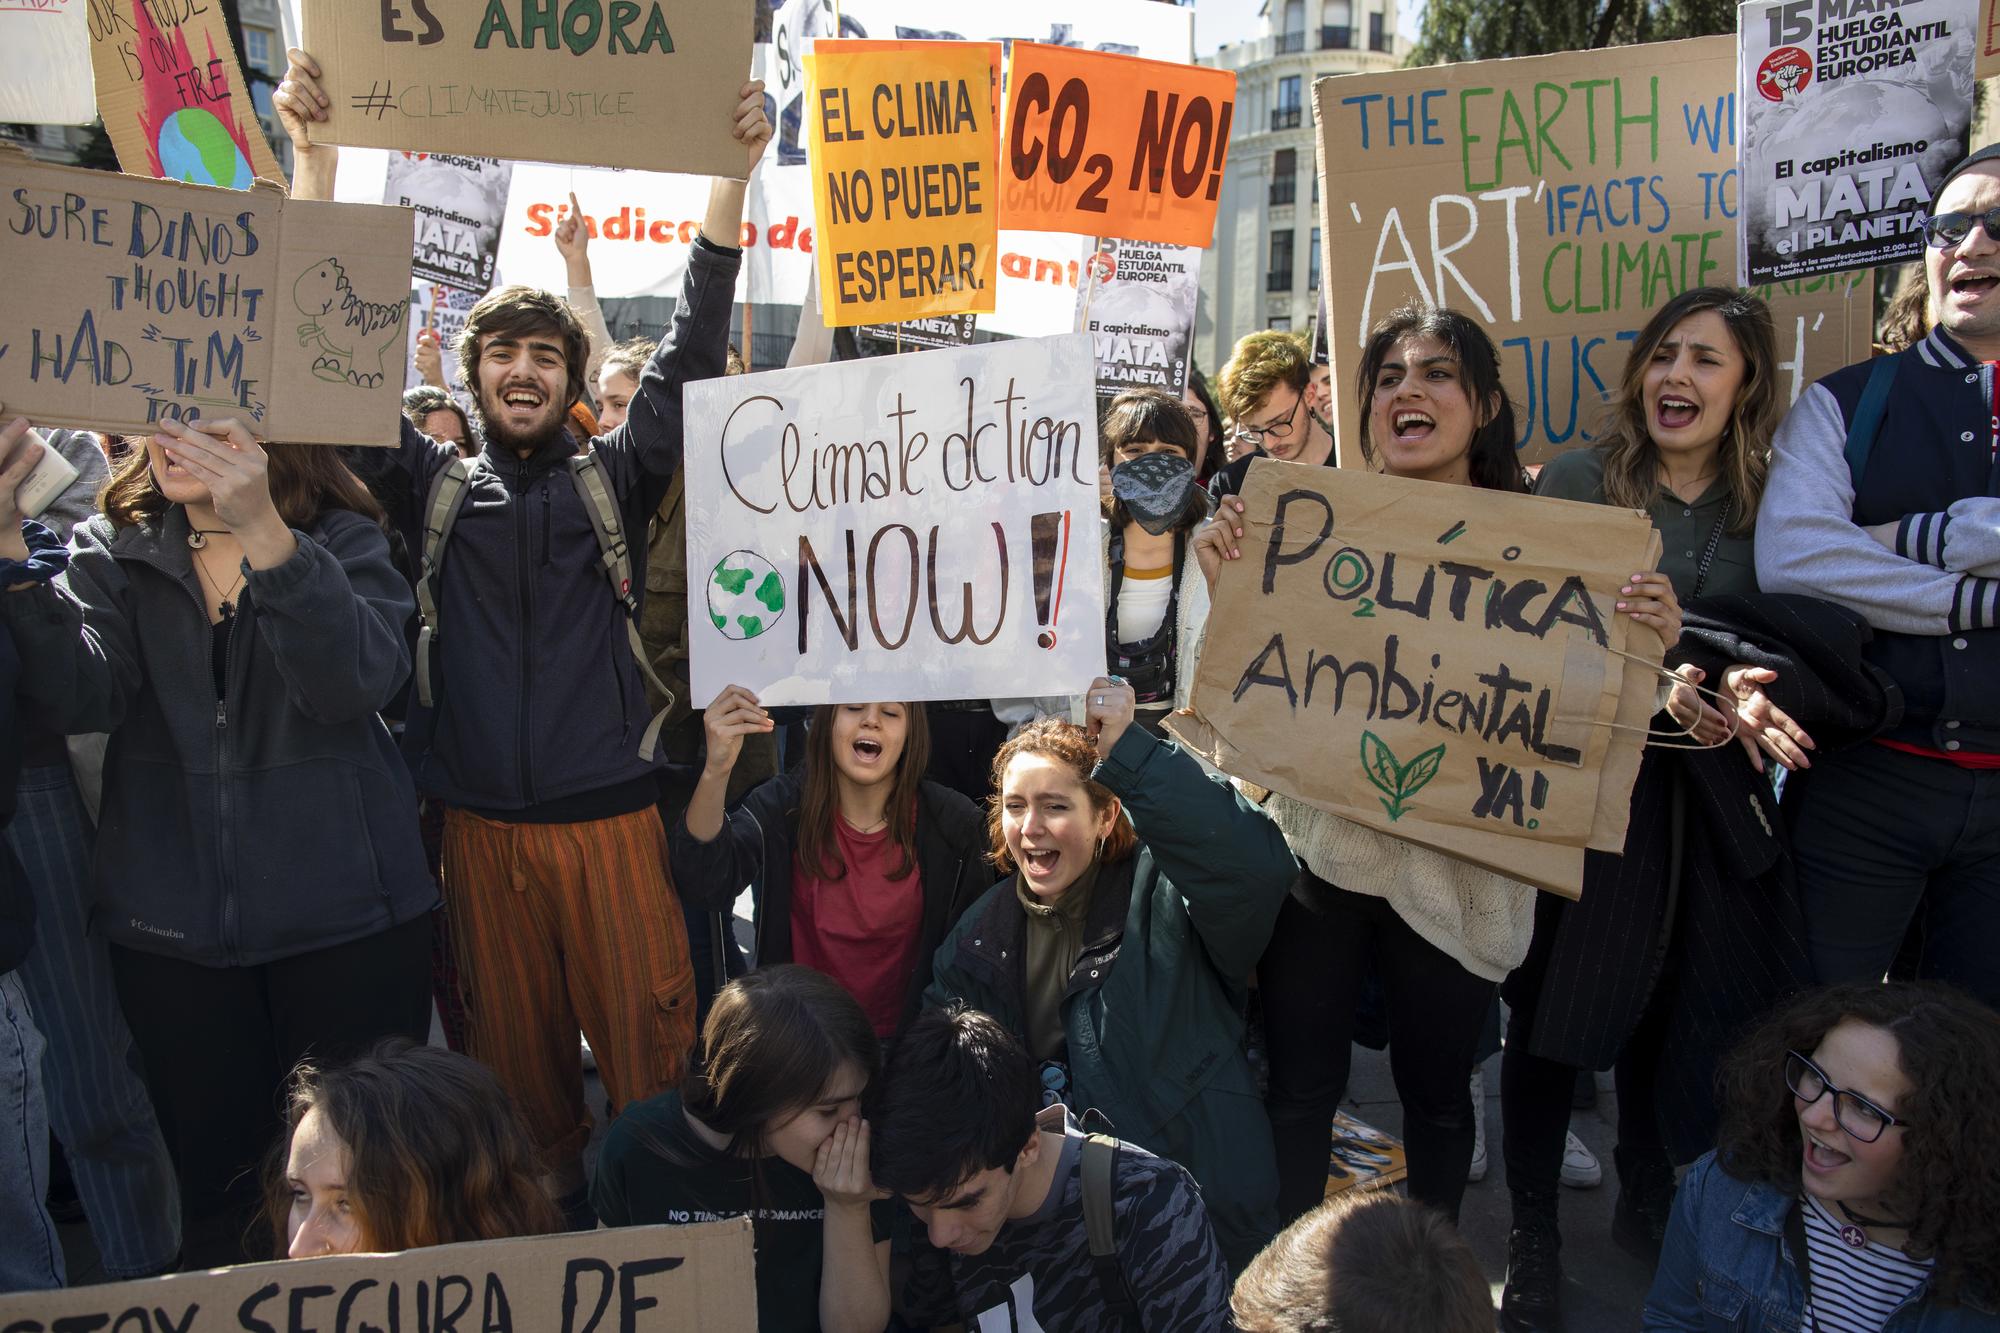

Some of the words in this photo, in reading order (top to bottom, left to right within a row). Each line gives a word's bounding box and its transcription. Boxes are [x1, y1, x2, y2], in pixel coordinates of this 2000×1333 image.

[381, 0, 444, 45] ES
[474, 0, 675, 56] AHORA
[1766, 2, 1813, 48] 15
[1817, 12, 1903, 45] HUELGA
[1817, 20, 1952, 64] ESTUDIANTIL
[150, 32, 179, 73] ON
[1816, 47, 1917, 83] EUROPEA
[174, 58, 231, 106] FIRE
[352, 80, 635, 120] #CLIMATEJUSTICE
[820, 87, 865, 143] EL
[872, 79, 977, 139] CLIMA
[1129, 89, 1232, 201] NO!
[1342, 89, 1447, 150] THE
[1460, 76, 1659, 192] EARTH
[430, 153, 482, 173] EUROPEA
[1775, 160, 1794, 180] El
[1801, 139, 1929, 176] capitalismo
[829, 167, 873, 224] NO
[883, 161, 982, 220] PUEDE
[1775, 162, 1933, 229] MATA
[9, 188, 113, 247] SURE
[128, 200, 259, 265] DINOS
[414, 203, 482, 229] capitalismo
[1776, 231, 1799, 255] el
[1807, 210, 1925, 250] PLANETA
[836, 242, 984, 304] ESPERAR.
[1116, 271, 1168, 283] EUROPEA
[1118, 260, 1186, 274] ESTUDIANTIL
[1119, 249, 1162, 261] HUELGA
[1543, 230, 1723, 313] CLIMATE
[1820, 249, 1877, 264] manifestaciones
[106, 263, 263, 321] THOUGHT
[30, 309, 132, 386] HAD
[1089, 321, 1100, 331] El
[1103, 323, 1170, 337] capitalismo
[1101, 366, 1167, 385] PLANETA
[721, 393, 929, 514] Climate
[1471, 756, 1549, 830] YA!
[137, 920, 184, 939] Columbia
[669, 1210, 689, 1222] NO
